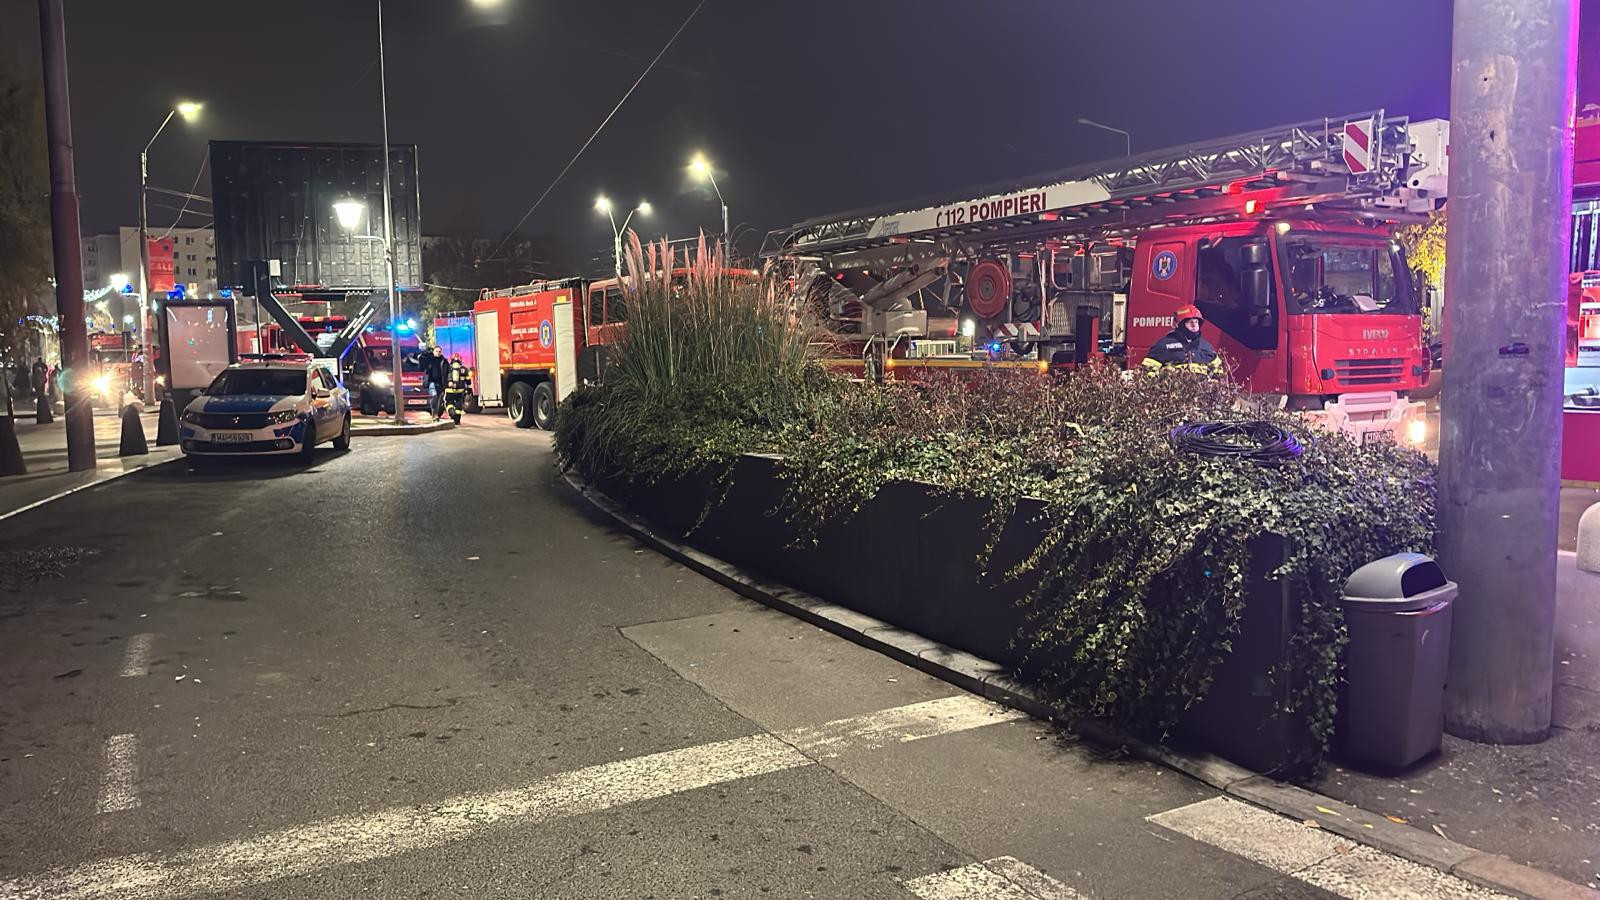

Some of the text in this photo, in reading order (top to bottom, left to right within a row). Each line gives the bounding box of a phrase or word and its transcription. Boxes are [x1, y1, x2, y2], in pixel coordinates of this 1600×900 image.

[944, 192, 1047, 226] 112 POMPIERI
[1133, 316, 1175, 328] POMPIE
